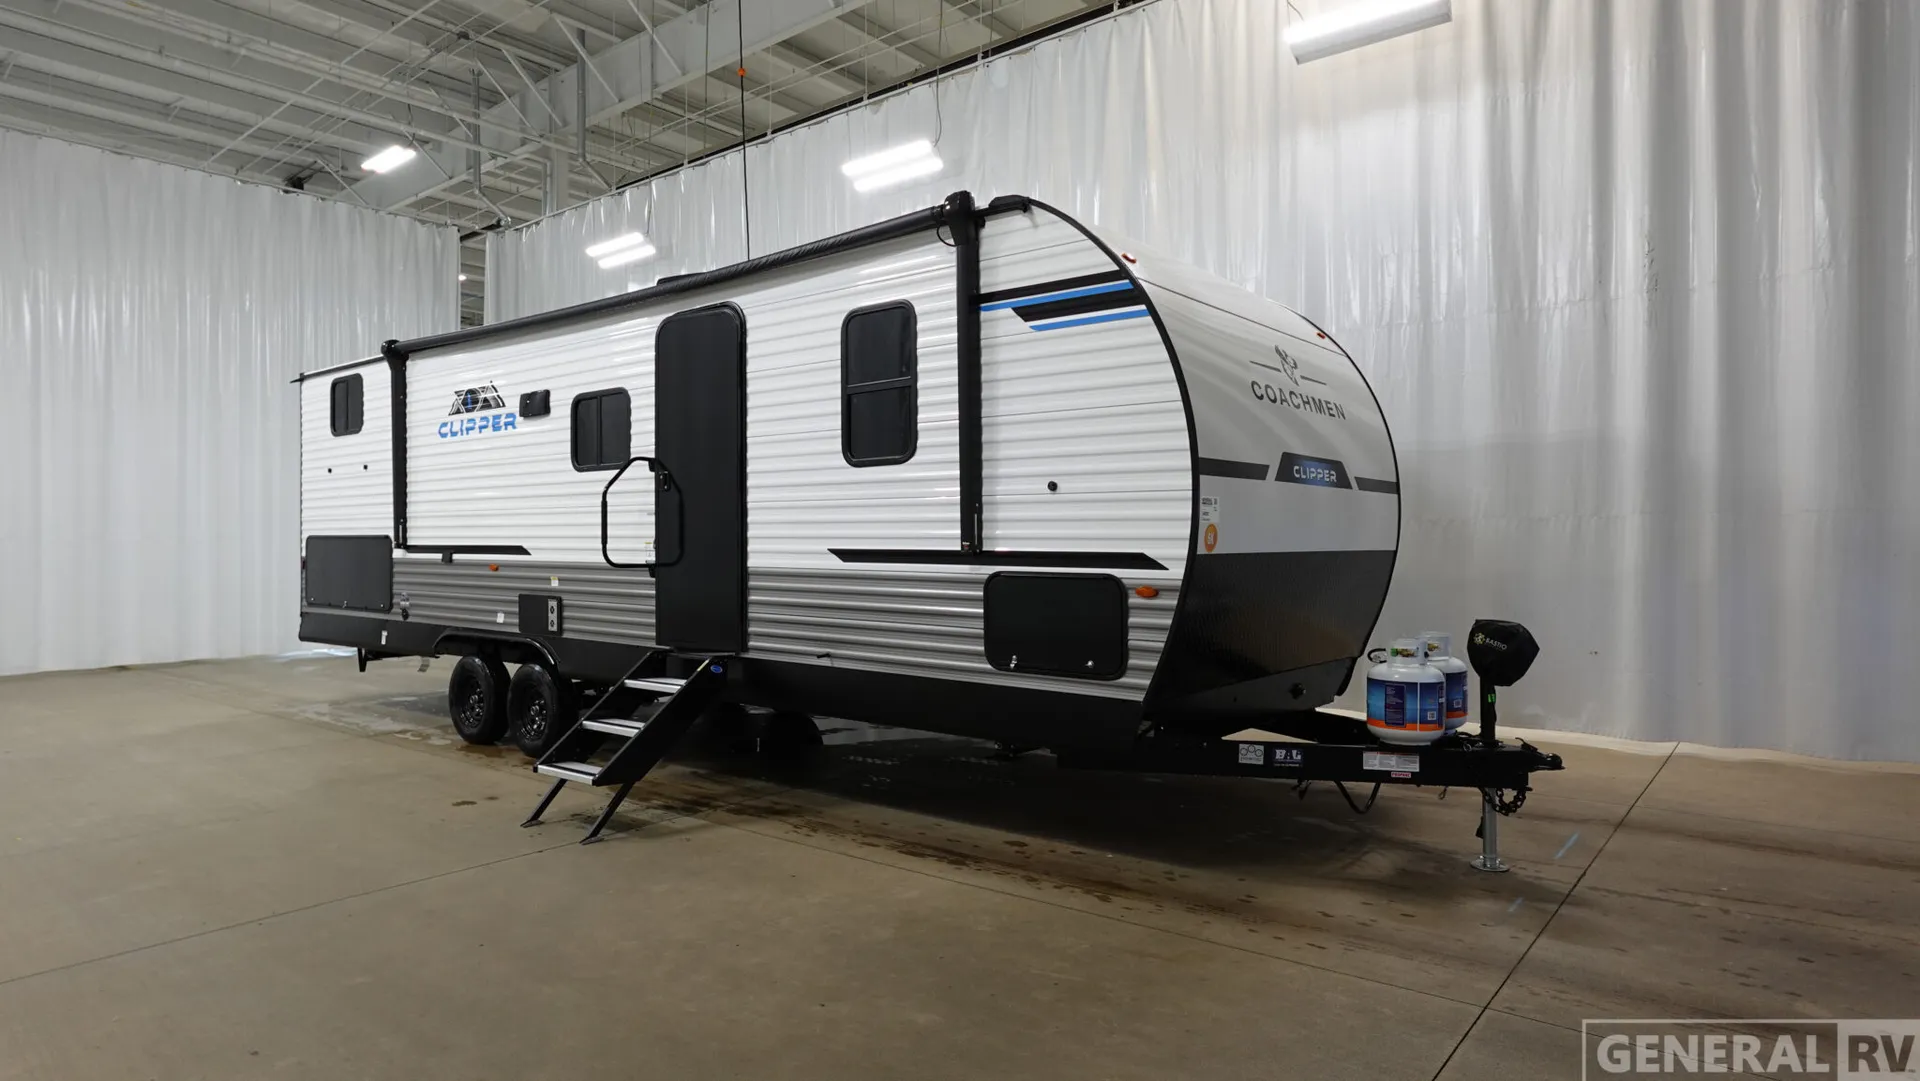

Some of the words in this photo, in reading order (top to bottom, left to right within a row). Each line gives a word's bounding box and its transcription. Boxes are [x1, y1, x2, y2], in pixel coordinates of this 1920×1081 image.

[1250, 380, 1347, 420] COACHMEN
[438, 412, 517, 438] CLIPPER
[1292, 465, 1338, 482] CLIPPER
